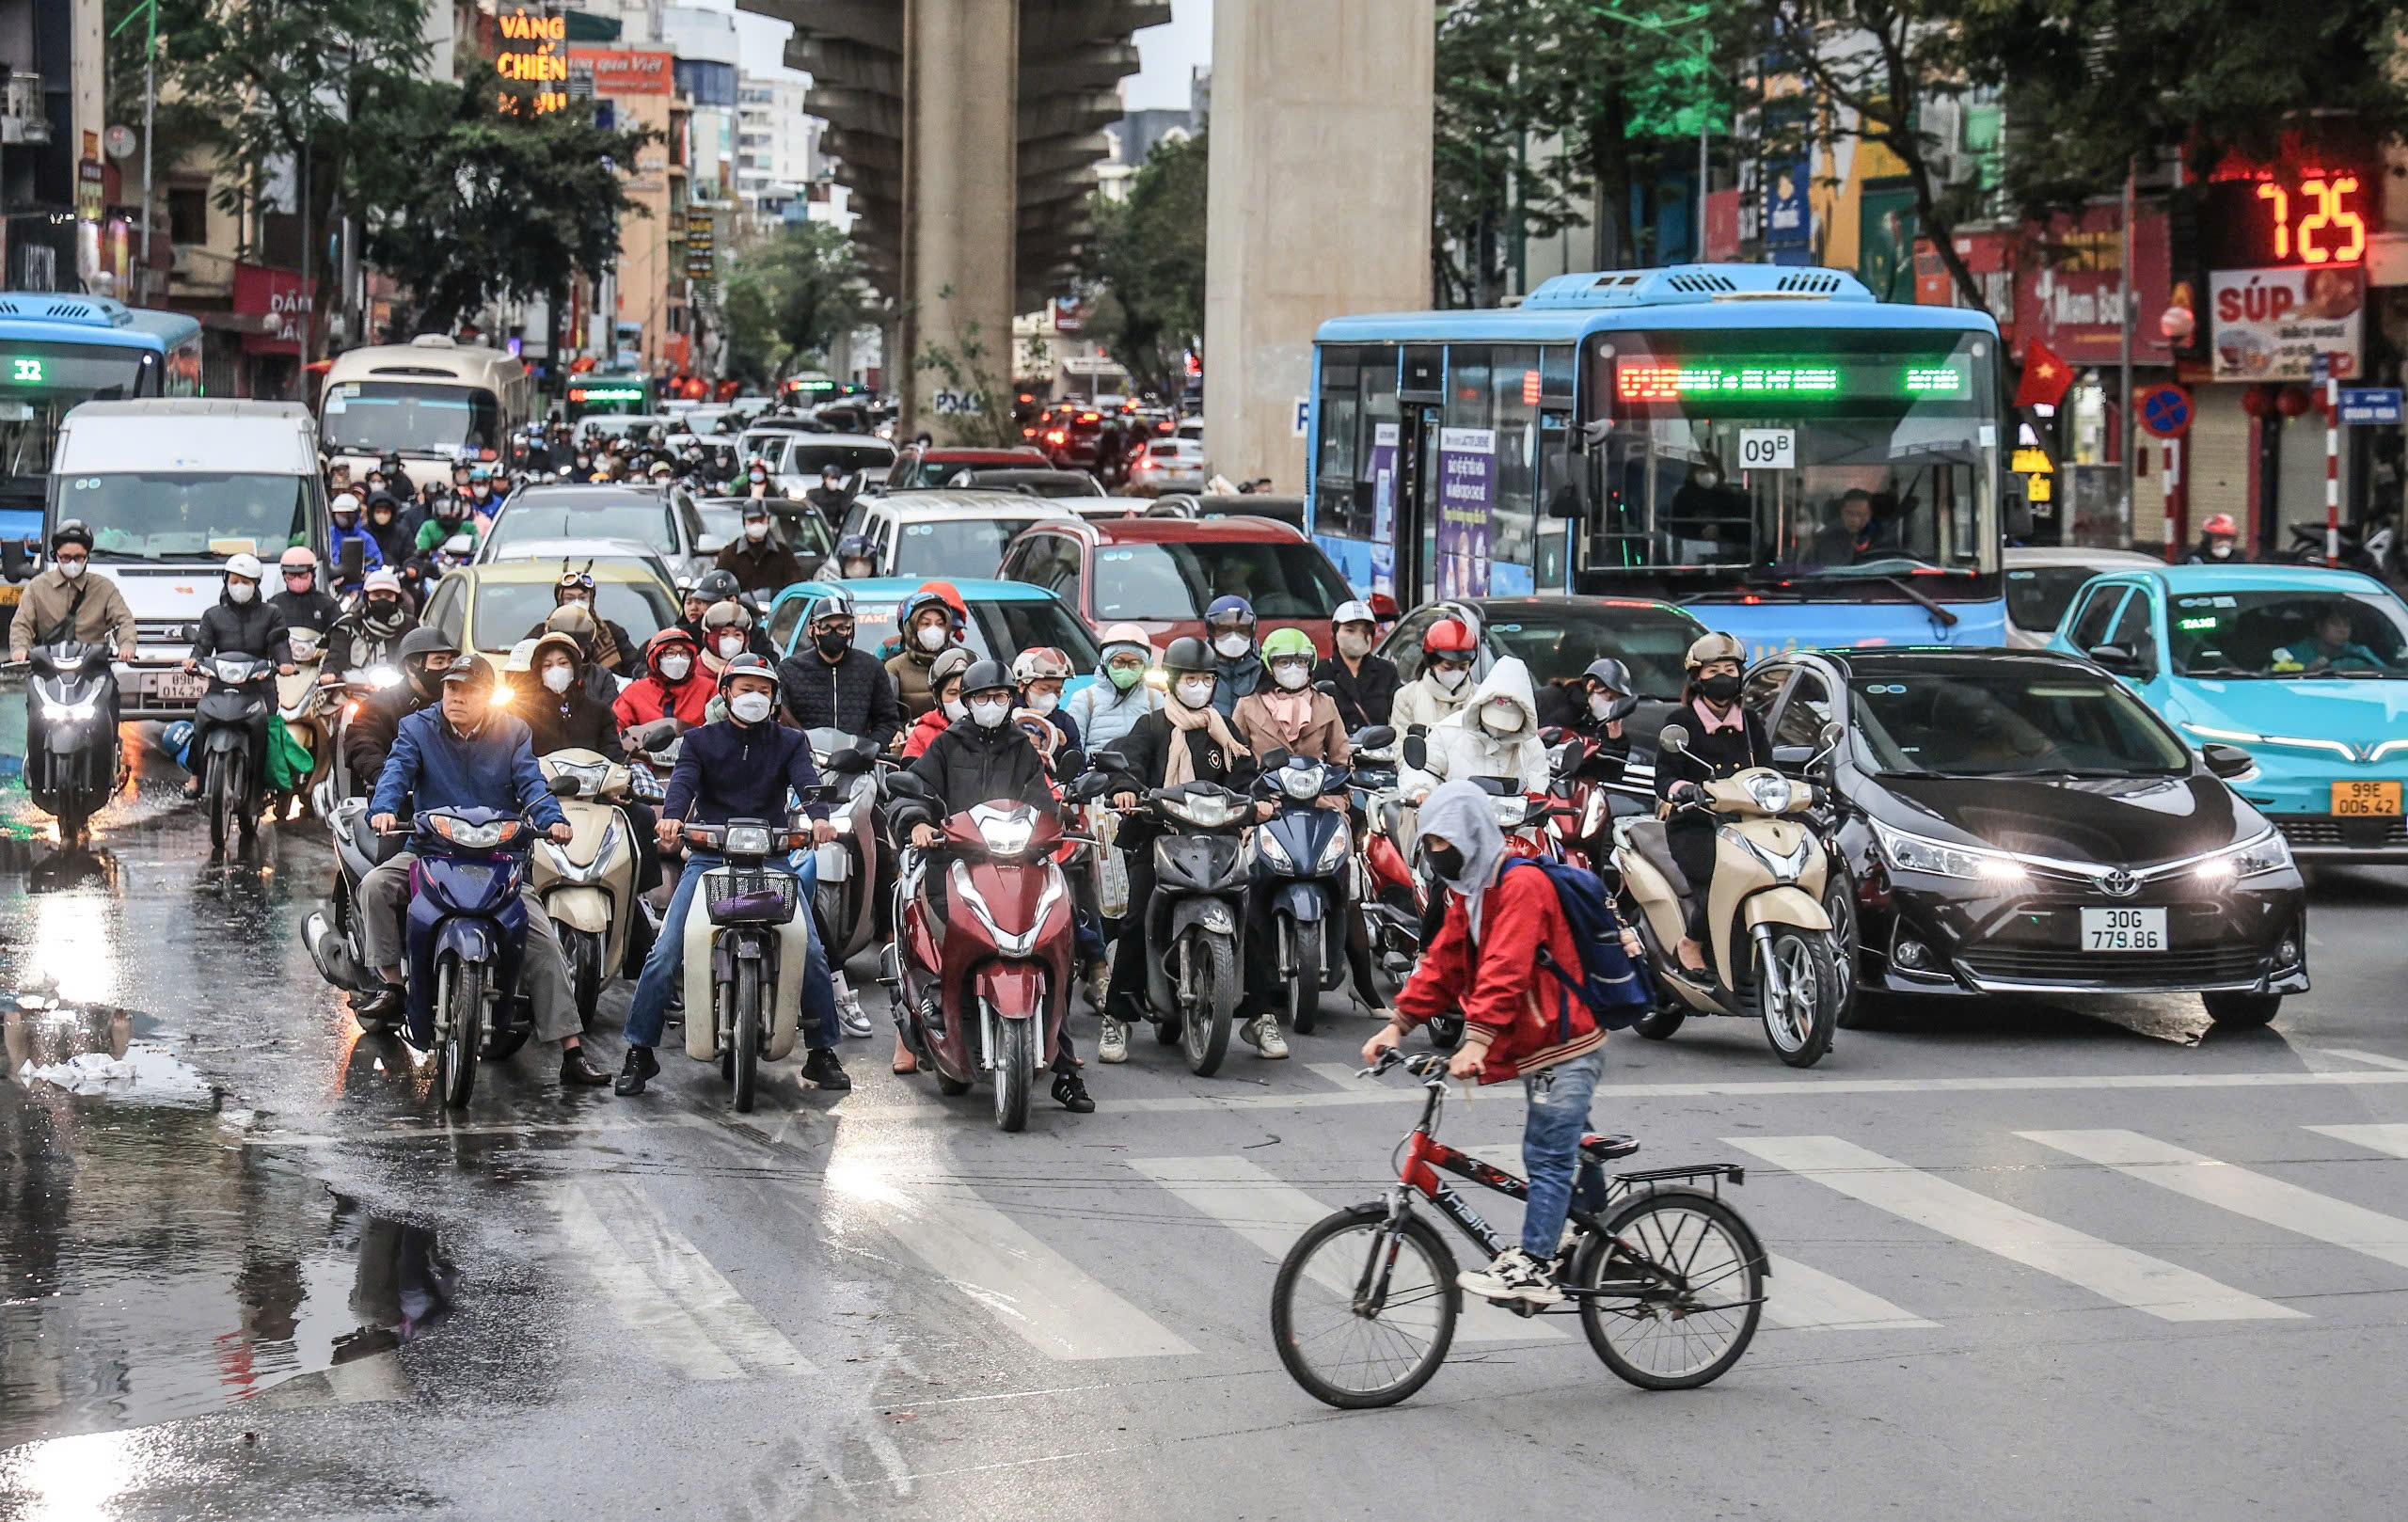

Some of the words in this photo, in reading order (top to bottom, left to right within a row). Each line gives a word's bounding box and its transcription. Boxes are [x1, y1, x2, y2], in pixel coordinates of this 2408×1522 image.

[497, 41, 566, 81] CHIẾN
[2218, 276, 2294, 323] SÚP
[15, 359, 42, 380] 32
[1745, 435, 1789, 462] 09B
[857, 614, 889, 625] TAXI
[2181, 617, 2216, 629] TAXI
[2352, 783, 2381, 798] 99E
[2106, 911, 2142, 928] 30G
[2091, 930, 2158, 949] 779.86
